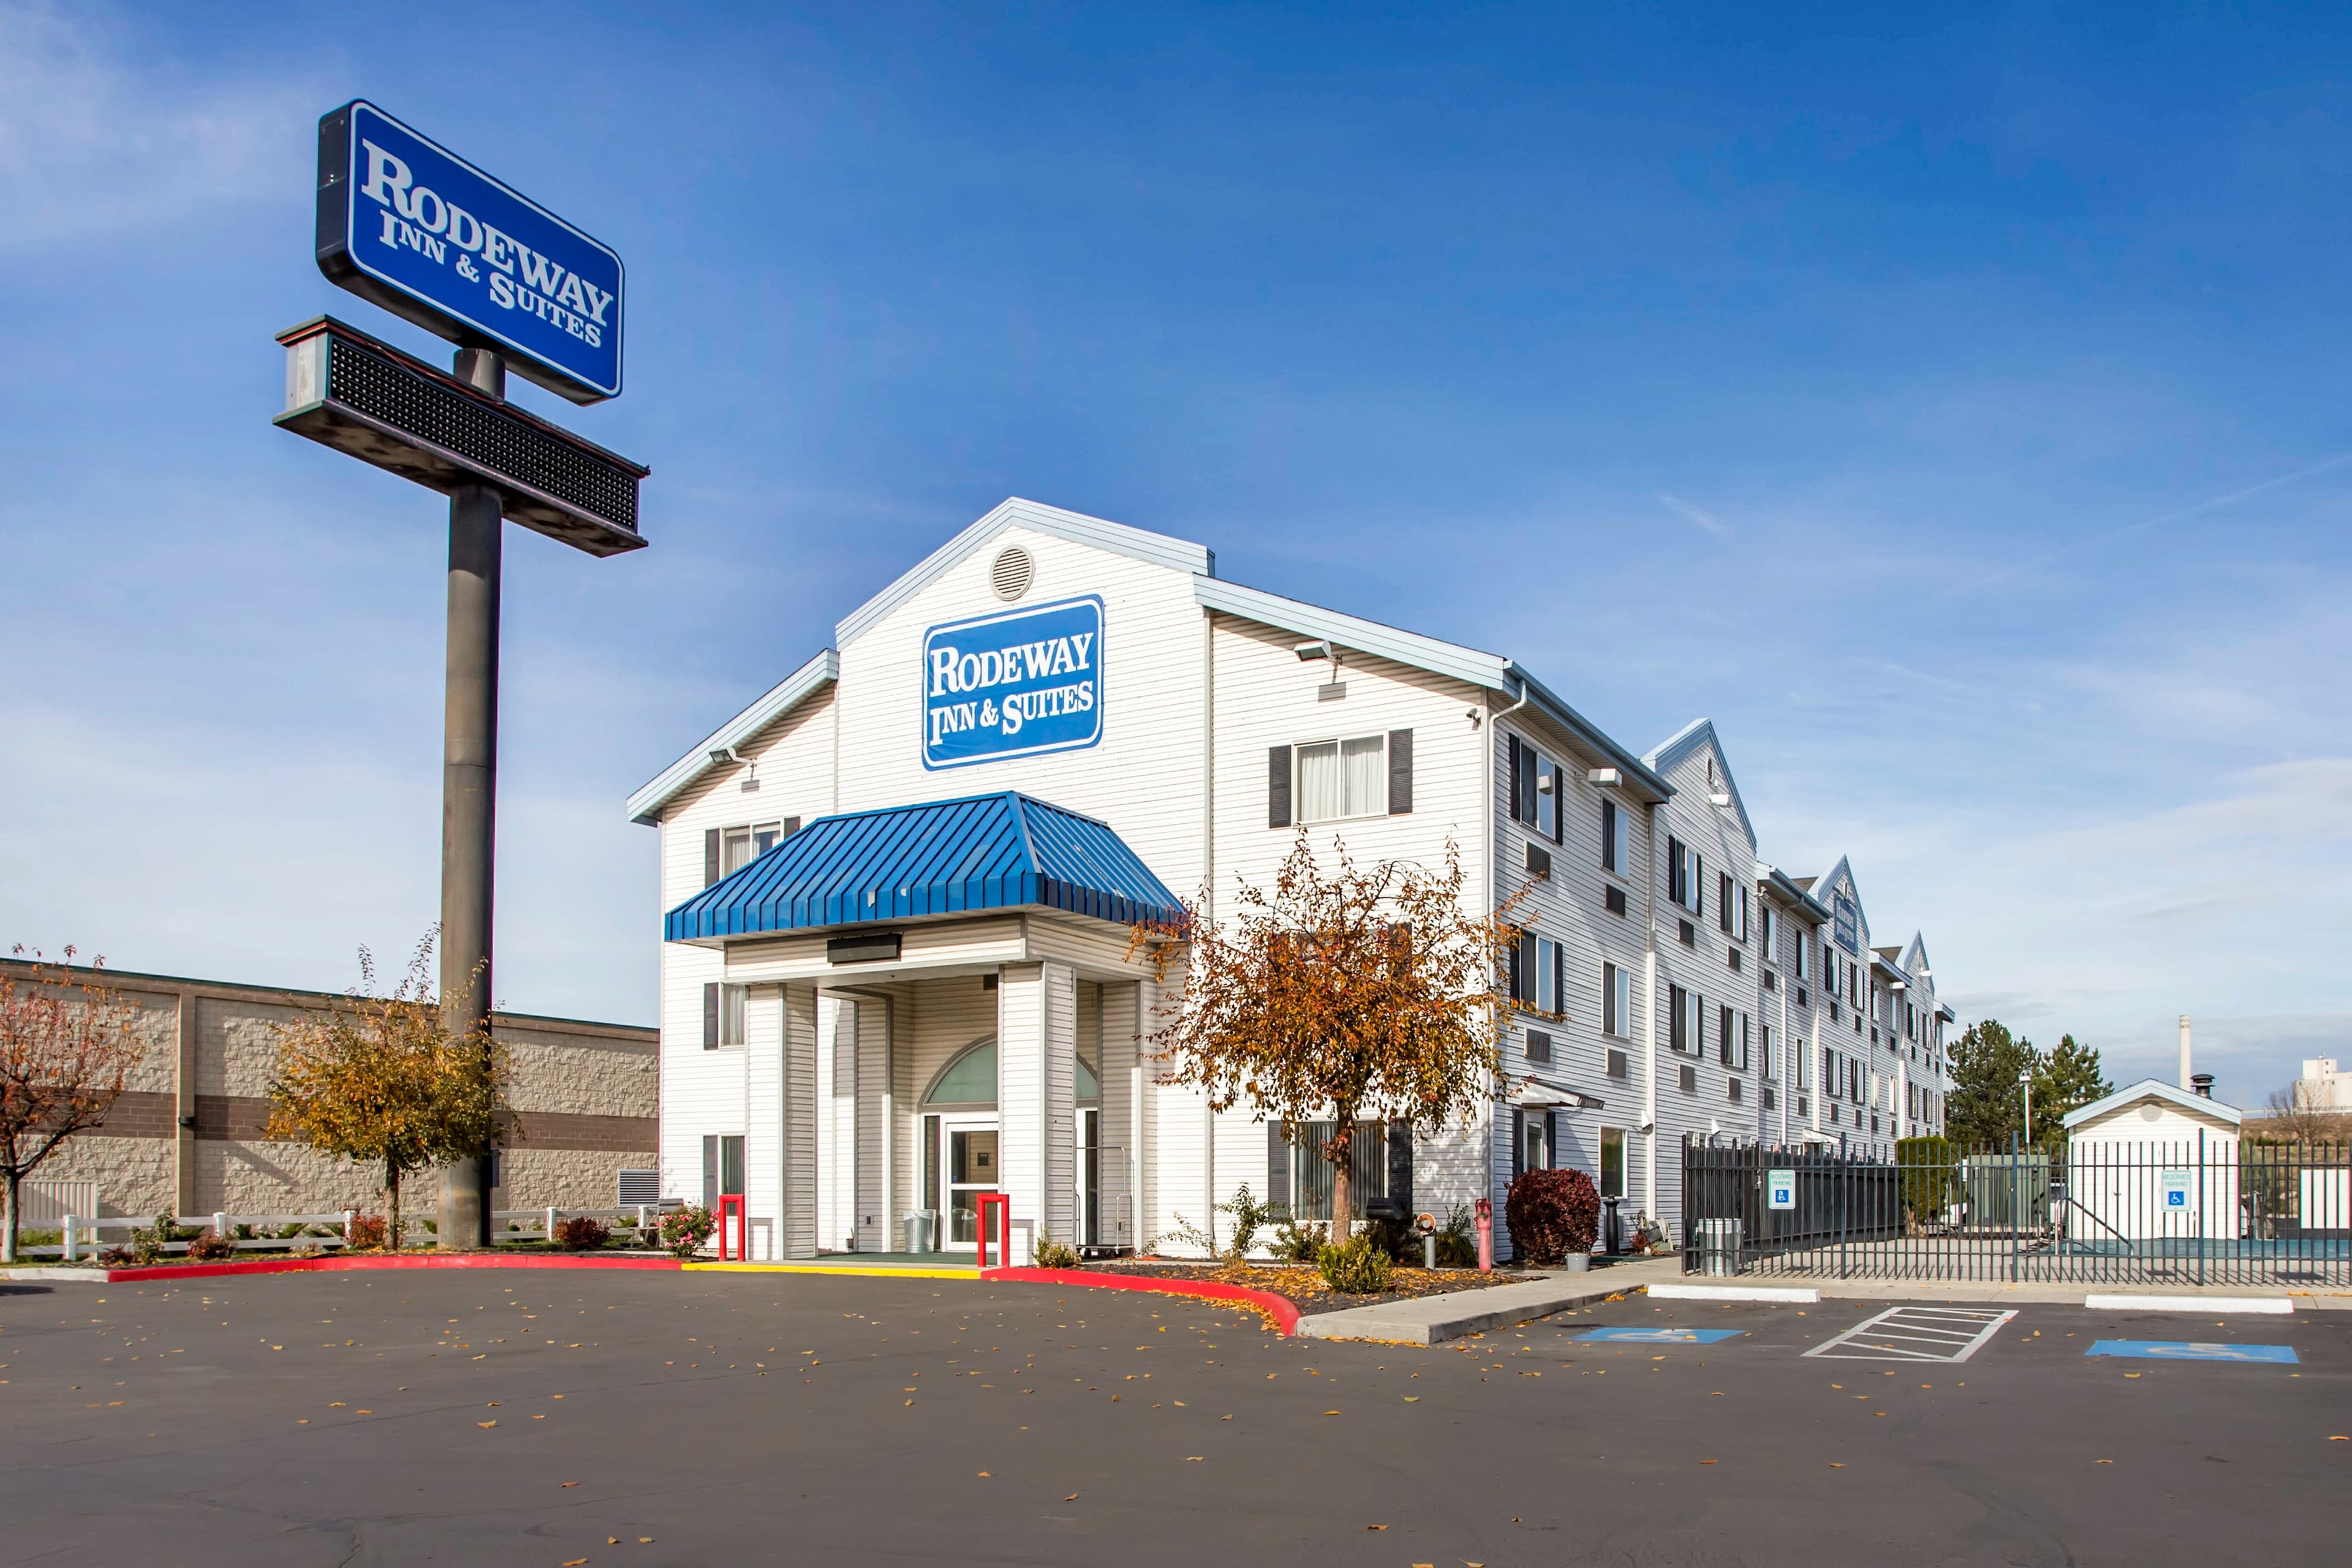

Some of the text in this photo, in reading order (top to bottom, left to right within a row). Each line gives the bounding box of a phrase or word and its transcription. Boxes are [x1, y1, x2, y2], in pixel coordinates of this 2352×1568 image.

[361, 138, 614, 327] RODEWAY
[379, 209, 602, 349] INN & SUITES
[930, 632, 1094, 698] RODEWAY
[930, 680, 1094, 747] INN & SUITES
